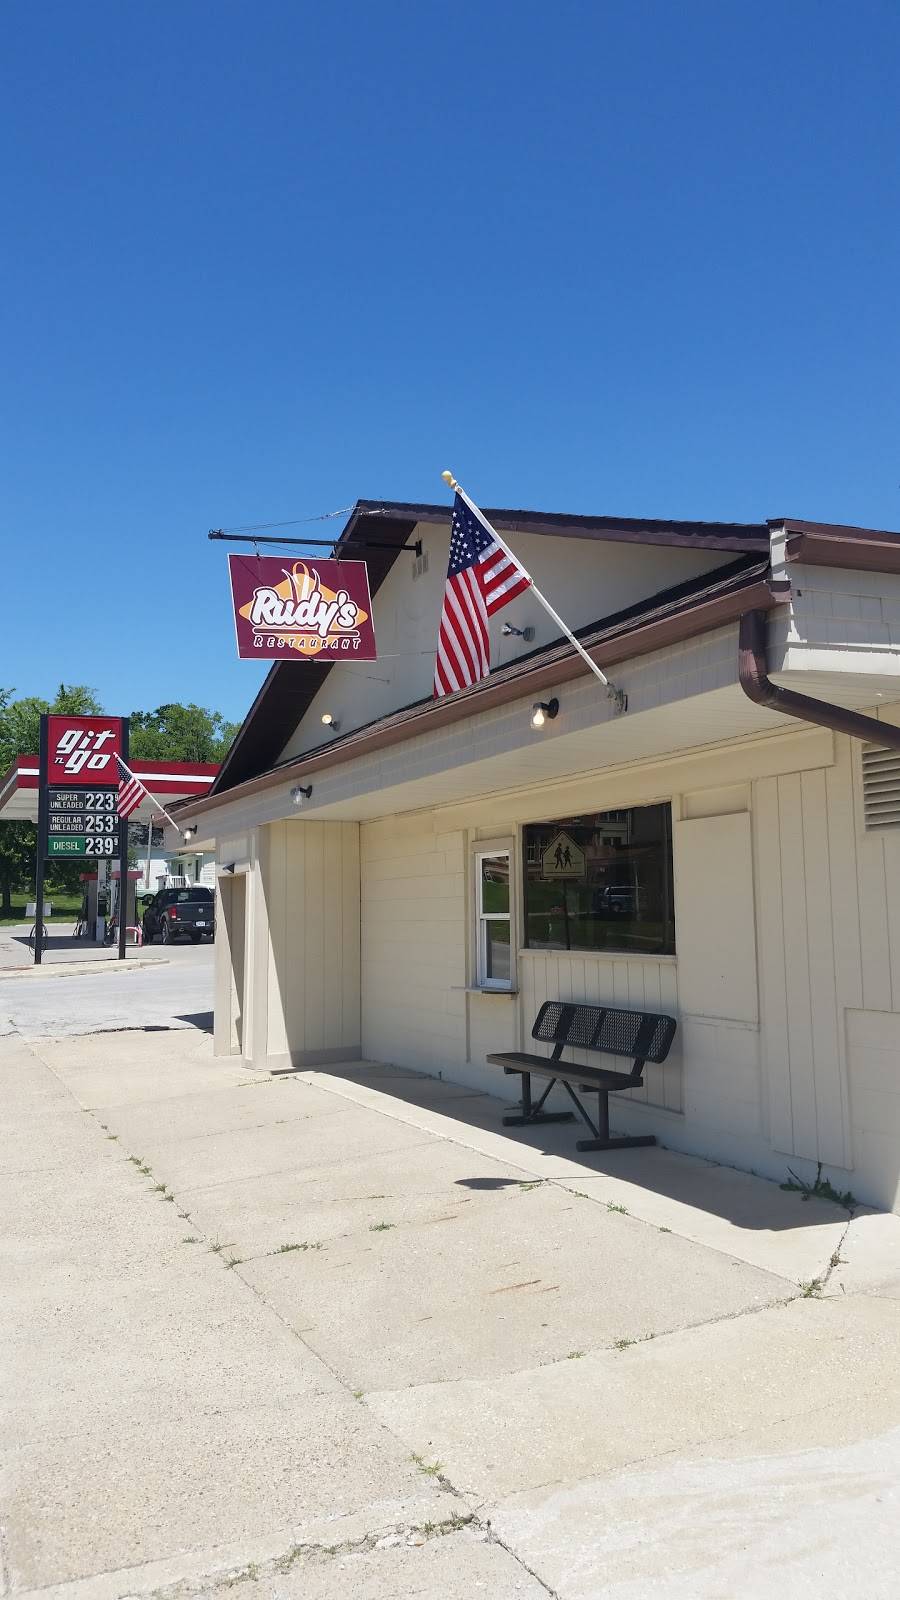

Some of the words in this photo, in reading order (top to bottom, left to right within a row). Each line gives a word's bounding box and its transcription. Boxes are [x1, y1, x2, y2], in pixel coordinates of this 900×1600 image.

[250, 587, 358, 638] Rudy's
[253, 636, 361, 649] RESTAURANT
[56, 730, 116, 754] git
[64, 750, 111, 774] go
[56, 793, 78, 801] SUPER
[50, 801, 84, 809] UNLEADED
[51, 816, 82, 824] REGULAR
[53, 841, 80, 851] DIESEL
